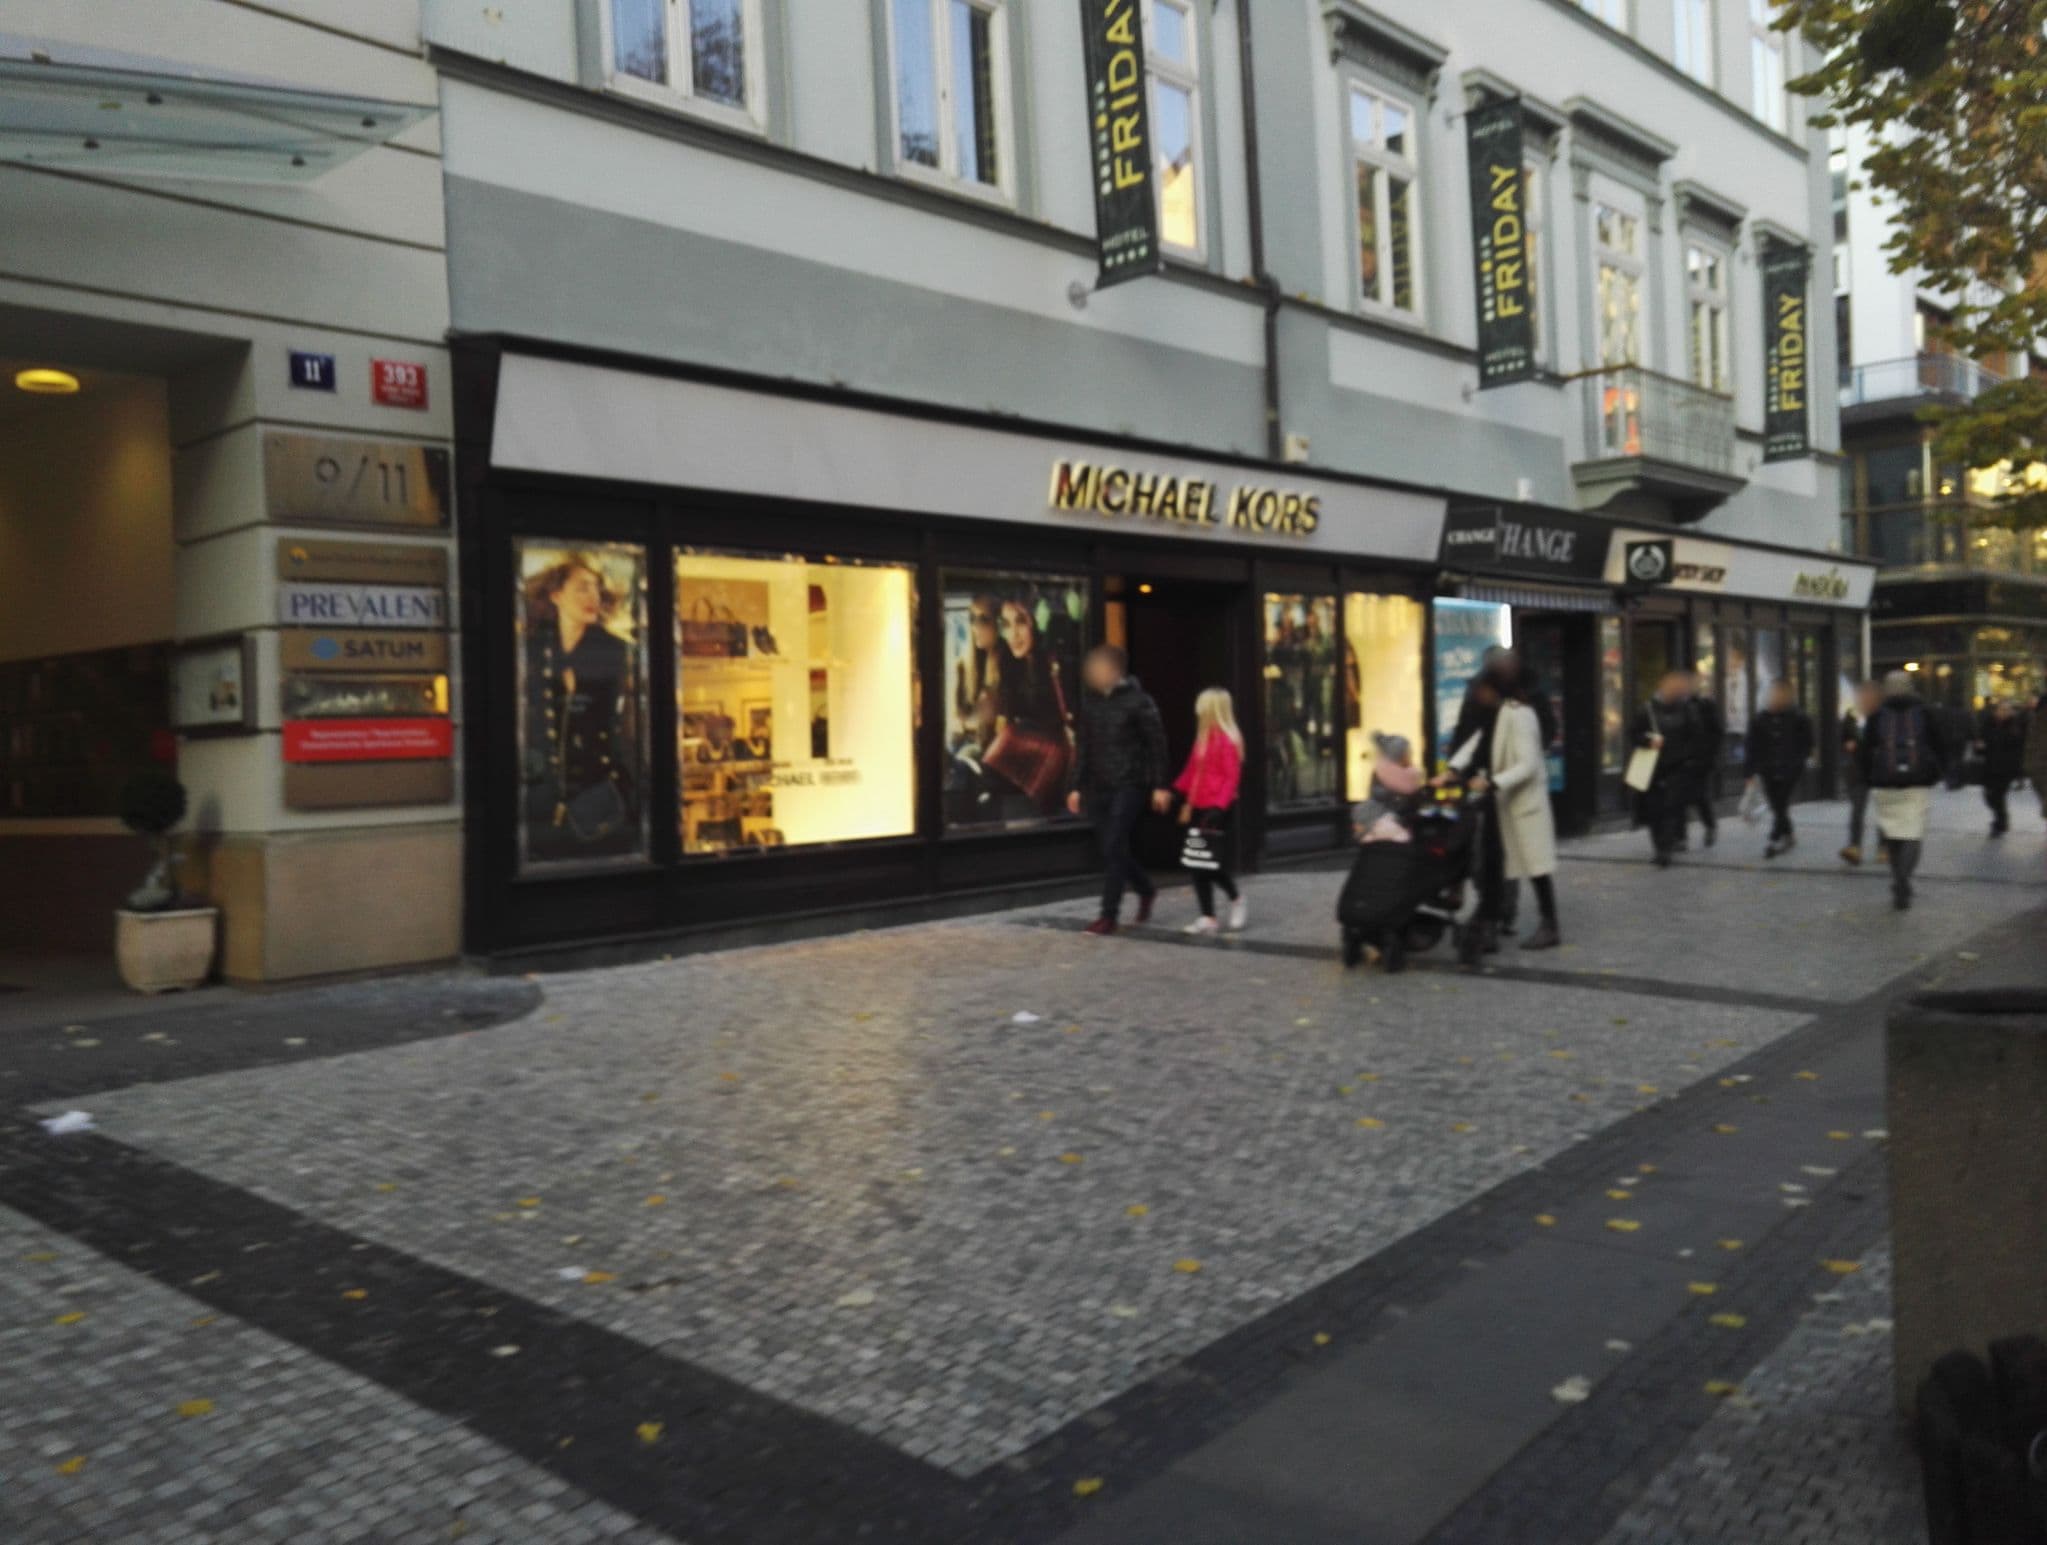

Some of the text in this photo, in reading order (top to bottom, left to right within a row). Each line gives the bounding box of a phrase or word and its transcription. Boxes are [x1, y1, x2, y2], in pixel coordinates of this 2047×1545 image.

[1490, 164, 1524, 318] FRIDAY
[304, 359, 321, 382] 11
[1778, 293, 1804, 412] FRIDAY
[1050, 457, 1321, 536] MICHAEL KORS
[1499, 521, 1577, 564] HANGE
[344, 639, 424, 658] SATUM
